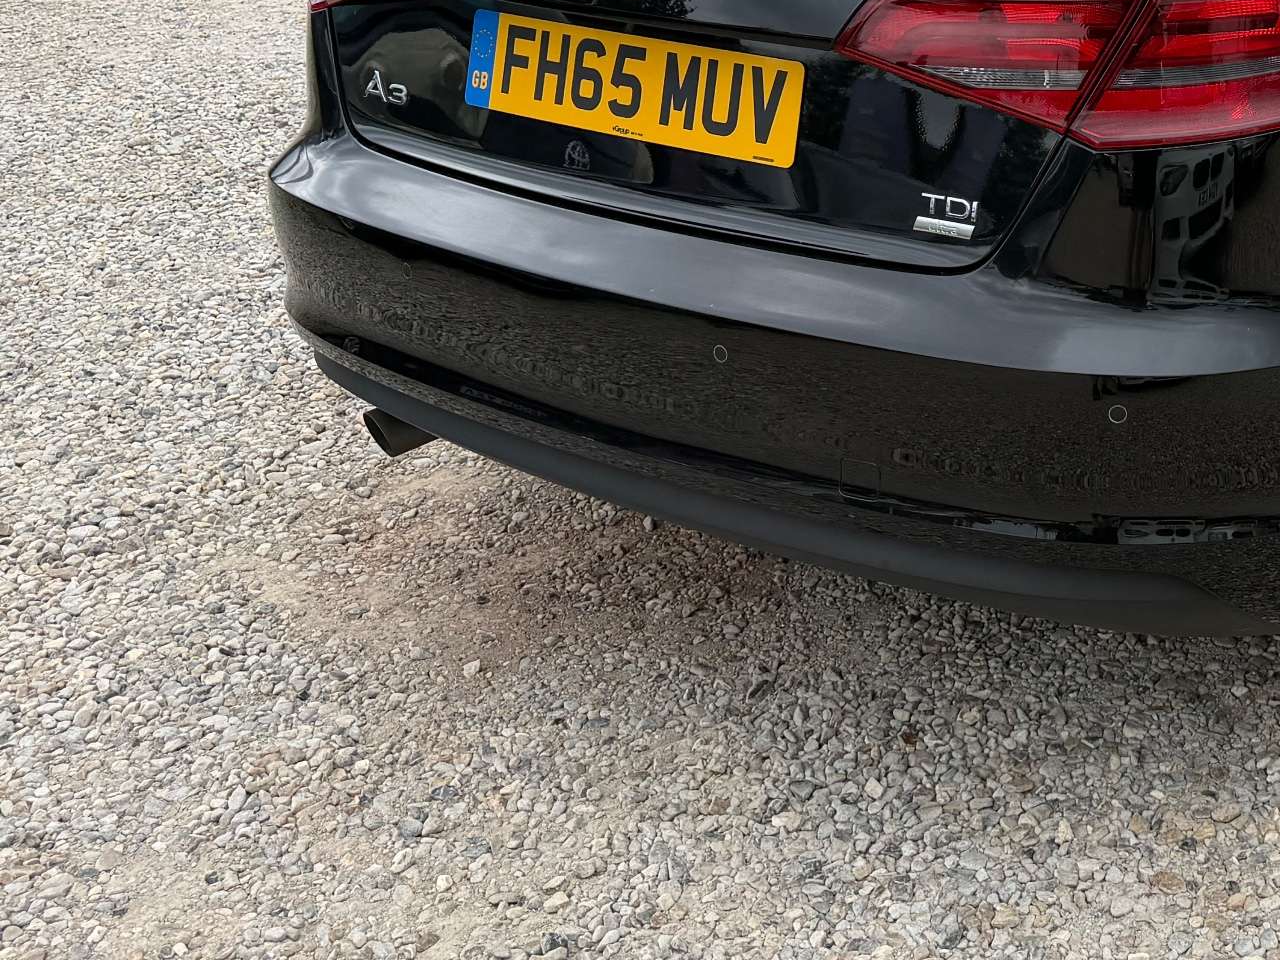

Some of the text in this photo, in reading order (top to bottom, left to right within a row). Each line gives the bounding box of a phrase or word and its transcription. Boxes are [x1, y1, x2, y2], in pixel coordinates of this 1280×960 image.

[363, 69, 408, 106] A3
[472, 70, 488, 90] GB
[501, 24, 788, 144] FH65 MUV
[921, 192, 978, 223] TDI
